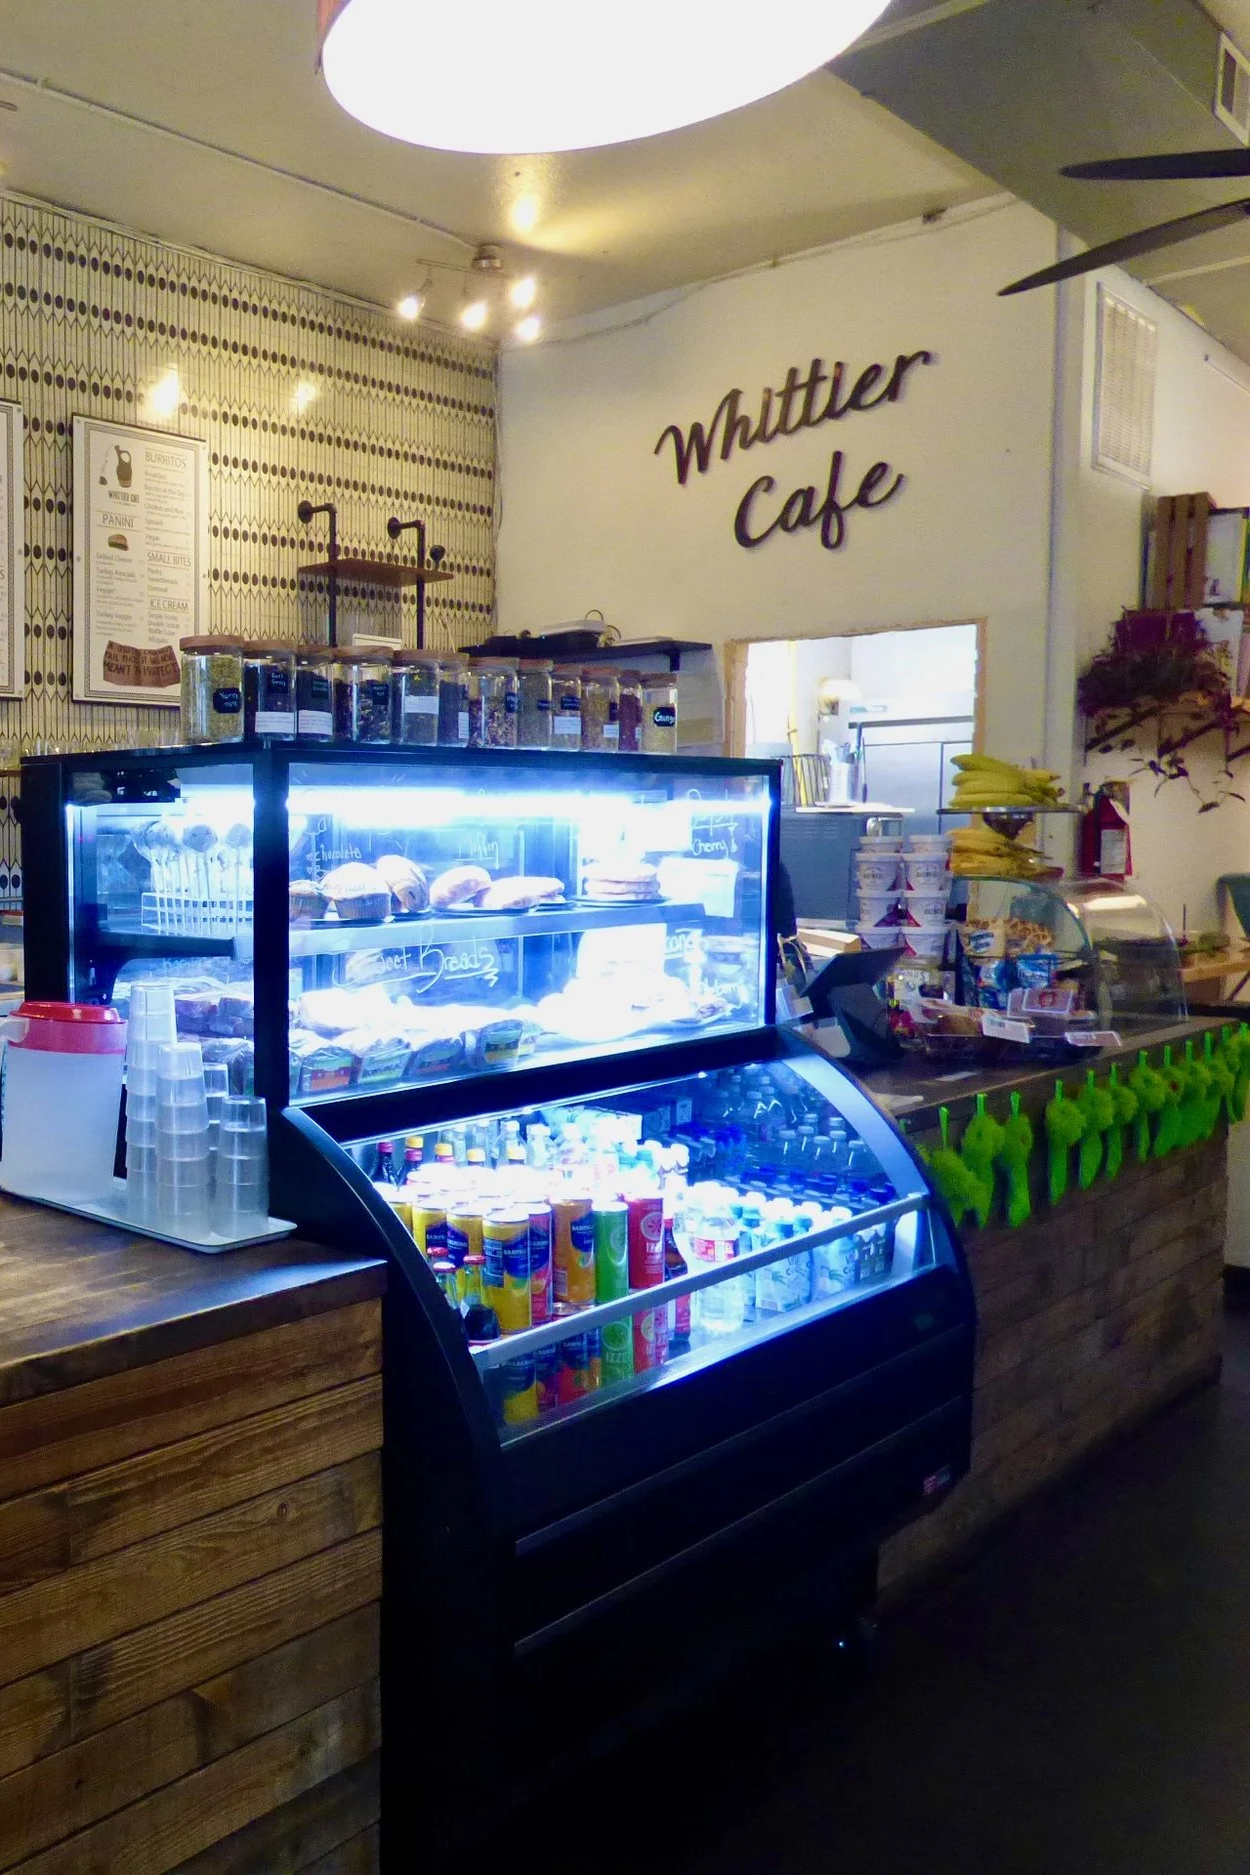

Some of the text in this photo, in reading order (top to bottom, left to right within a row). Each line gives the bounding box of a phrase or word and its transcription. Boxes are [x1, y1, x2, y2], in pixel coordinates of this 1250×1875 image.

[654, 350, 931, 484] Whittier
[144, 451, 187, 469] BURRITOS
[734, 450, 905, 550] Cafe
[102, 514, 134, 528] PANINI
[147, 551, 192, 567] SMALL BITES
[150, 598, 162, 609] ICE
[162, 600, 189, 611] CREAM
